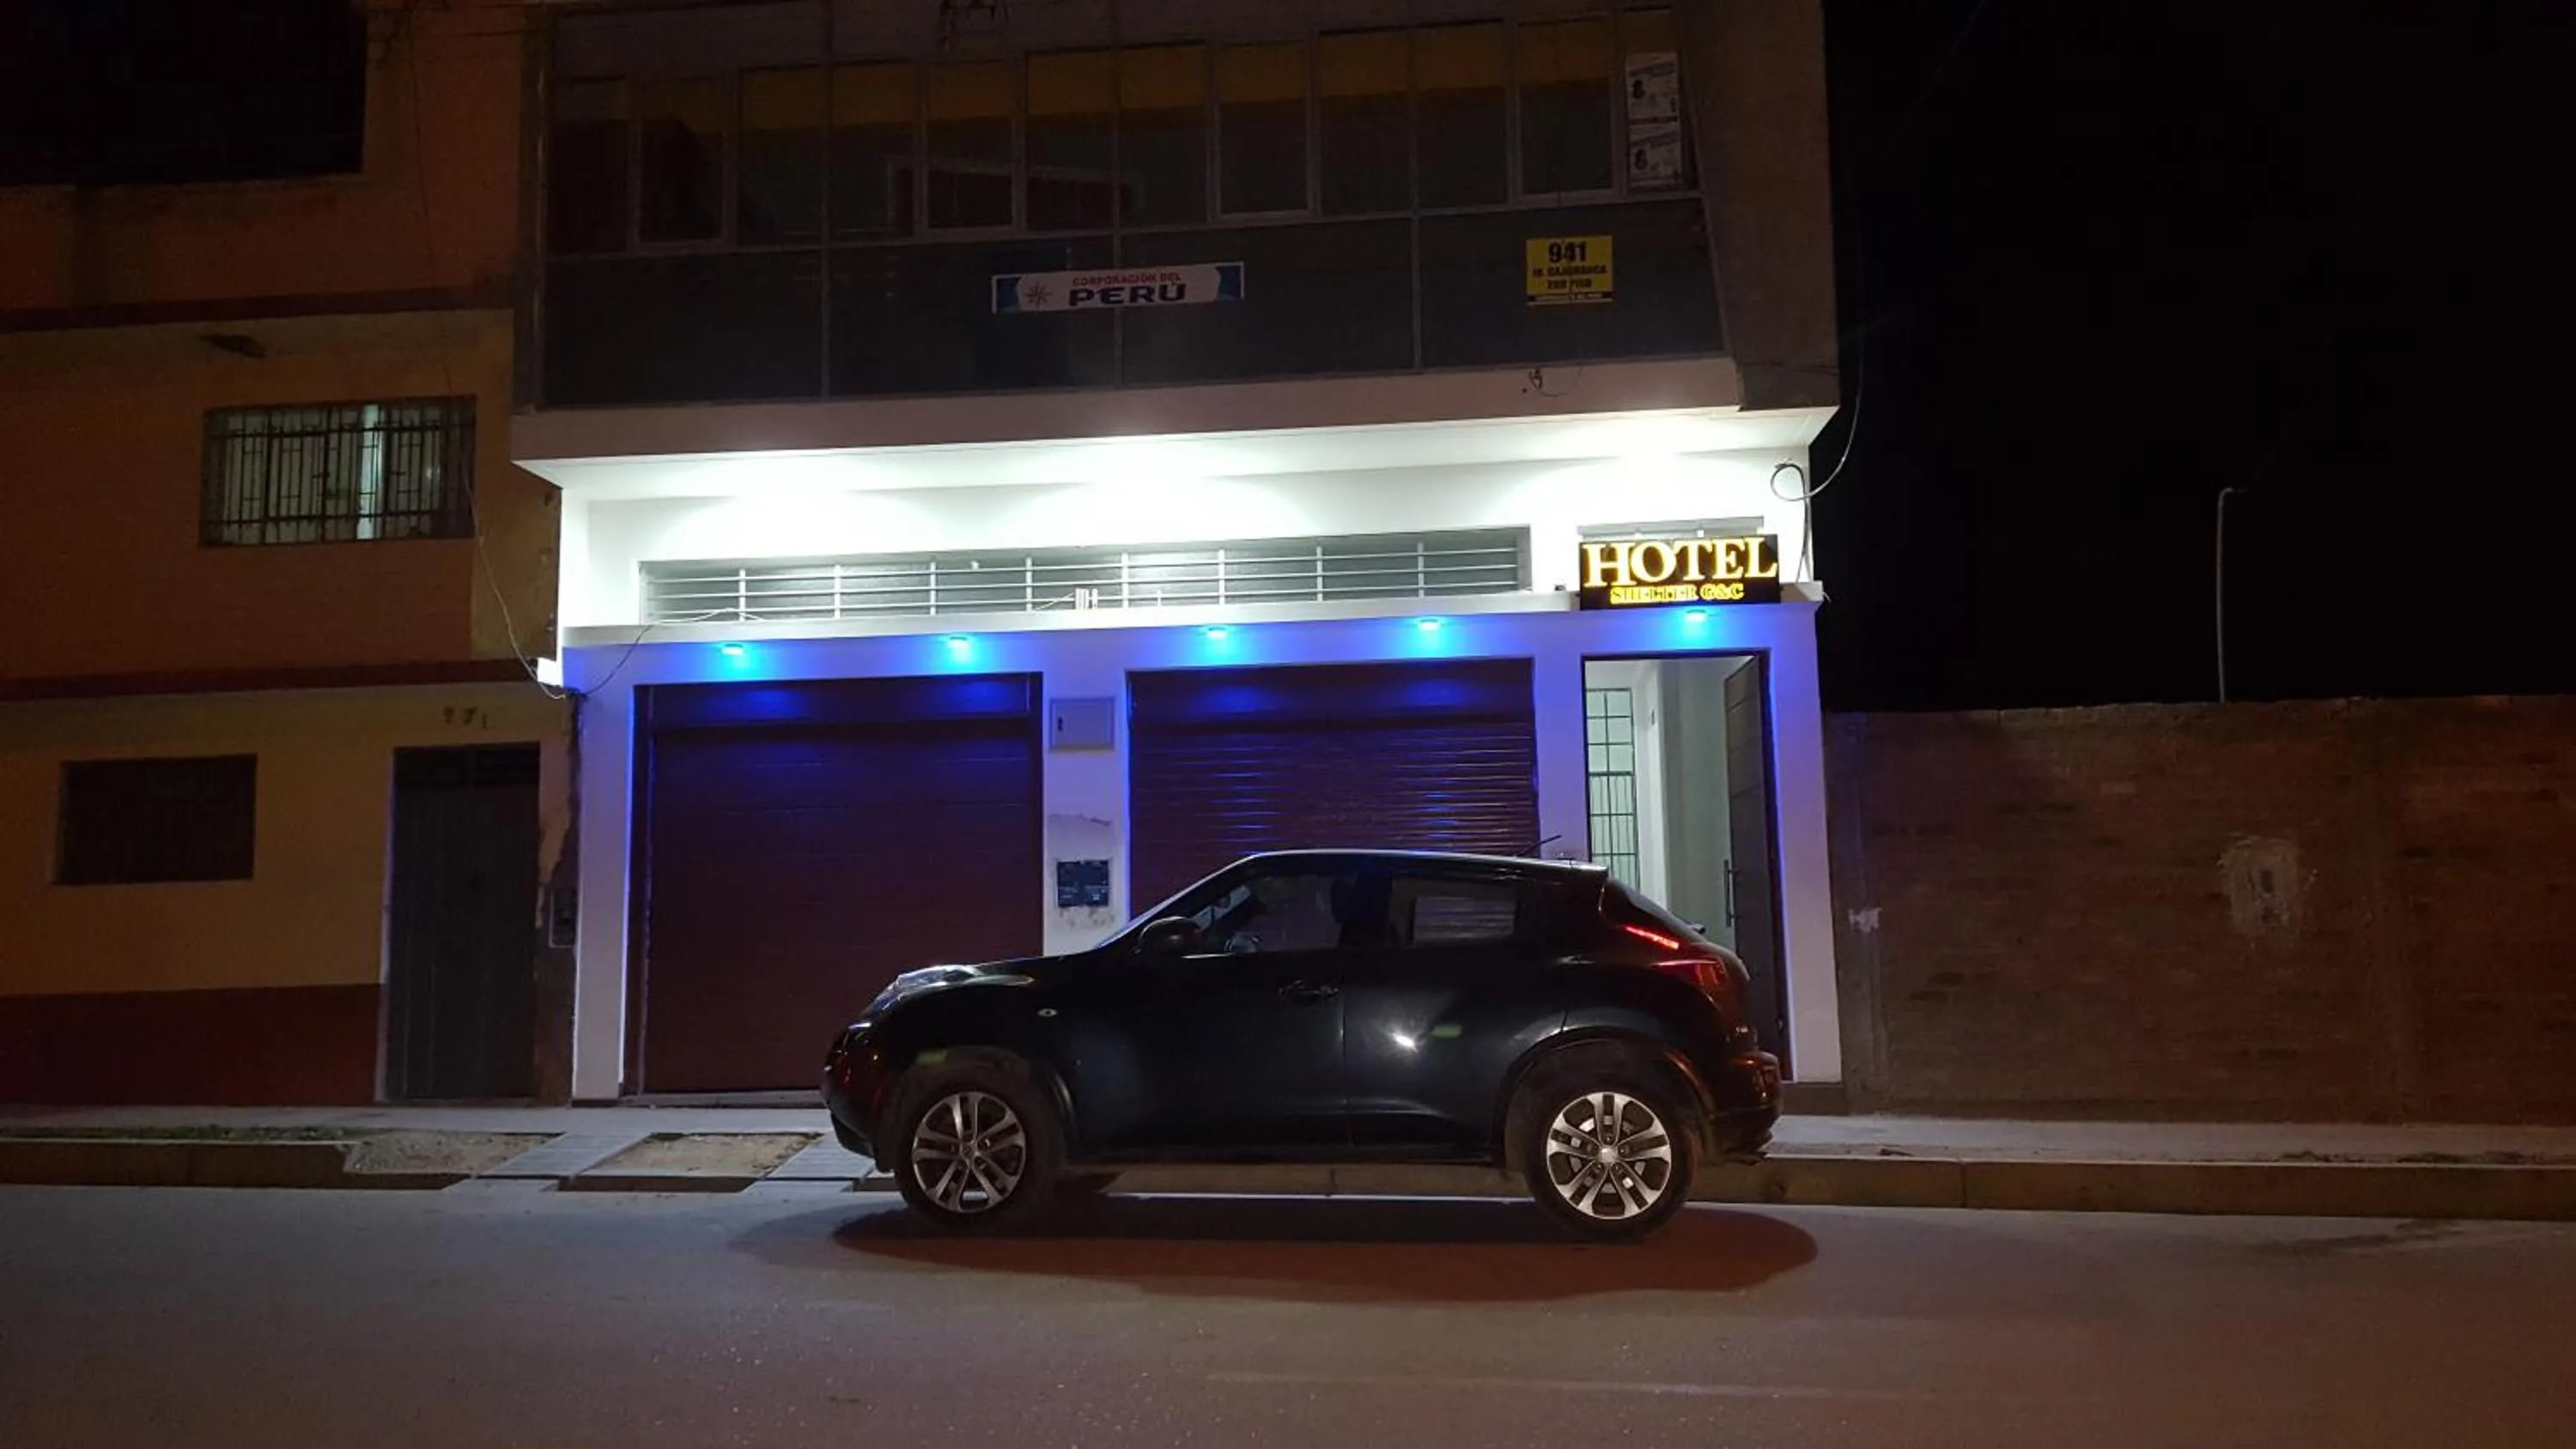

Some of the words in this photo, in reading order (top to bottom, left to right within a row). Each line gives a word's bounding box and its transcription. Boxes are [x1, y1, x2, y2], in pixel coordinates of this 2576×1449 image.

[1548, 241, 1588, 264] 941
[1160, 271, 1182, 283] DEL
[1582, 537, 1778, 587] HOTEL
[1699, 583, 1745, 600] G&C
